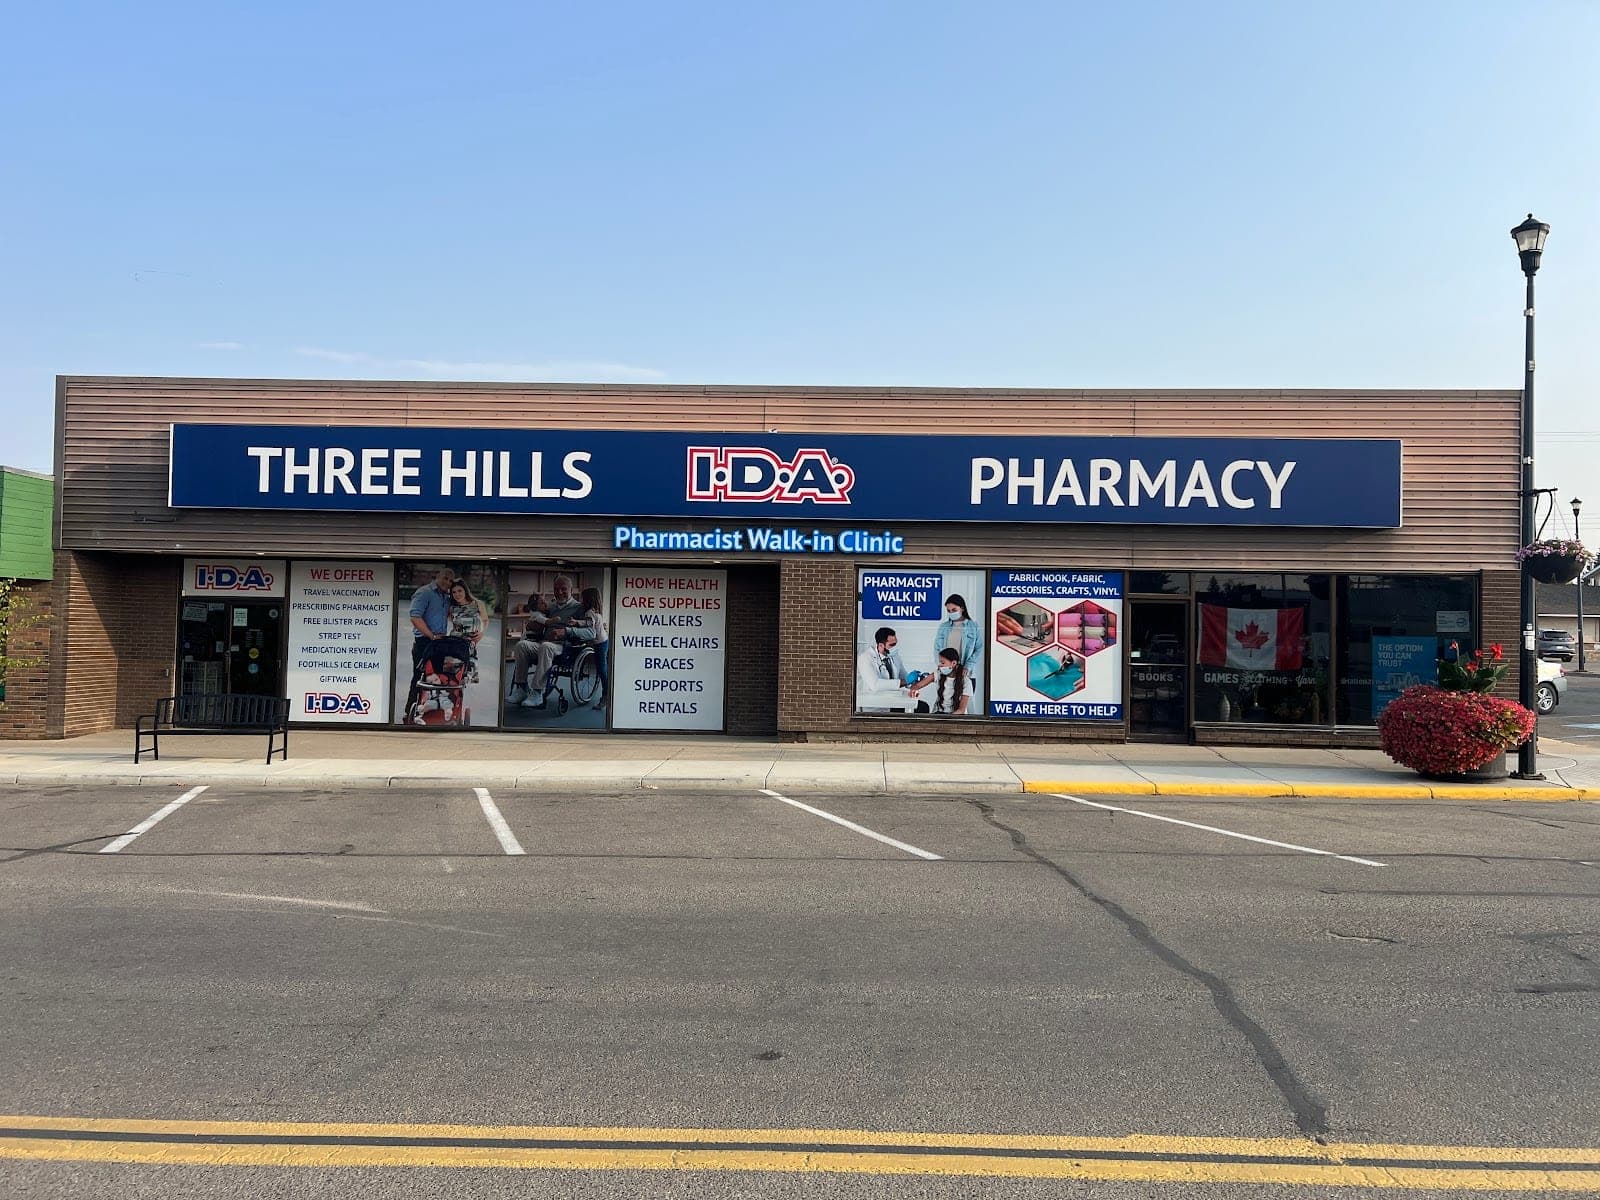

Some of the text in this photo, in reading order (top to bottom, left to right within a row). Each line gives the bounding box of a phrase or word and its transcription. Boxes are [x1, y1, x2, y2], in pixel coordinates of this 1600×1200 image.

[248, 447, 592, 498] THREE HILLS
[971, 458, 1296, 508] PHARMACY
[615, 526, 904, 554] Pharmacist Walk-in Clinic
[310, 569, 374, 581] WE OFFER
[1008, 573, 1106, 584] FABRIC NOOK, FABRIC,
[625, 577, 719, 590] HOME HEALTH
[863, 577, 941, 588] PHARMACIST
[303, 588, 380, 597] TRAVEL VACCINATION
[877, 591, 927, 602] WALK IN
[995, 586, 1055, 596] ACCESSORIES,
[1056, 586, 1092, 597] CRAFTS,
[621, 597, 721, 610] CARE SUPPLIES
[882, 605, 921, 617] CLINIC
[303, 617, 321, 625] FREE
[323, 618, 353, 626] BLISTER
[640, 614, 703, 627] WALKERS
[318, 632, 341, 640] STREP
[621, 636, 719, 649] WHEEL CHAIRS
[301, 646, 378, 655] MEDICATION REVIEW
[1395, 652, 1412, 660] CAN
[298, 660, 380, 669] FOOTHILLS ICE CREAM
[644, 657, 694, 670] BRACES
[1378, 659, 1402, 667] TRUST
[319, 675, 357, 683] GIFTWARE
[1138, 673, 1174, 681] BOOKS
[1204, 672, 1239, 684] GAMES
[634, 679, 704, 692] SUPPORTS
[639, 701, 697, 714] RENTALS
[995, 703, 1118, 716] WE ARE HERE TO HELP
